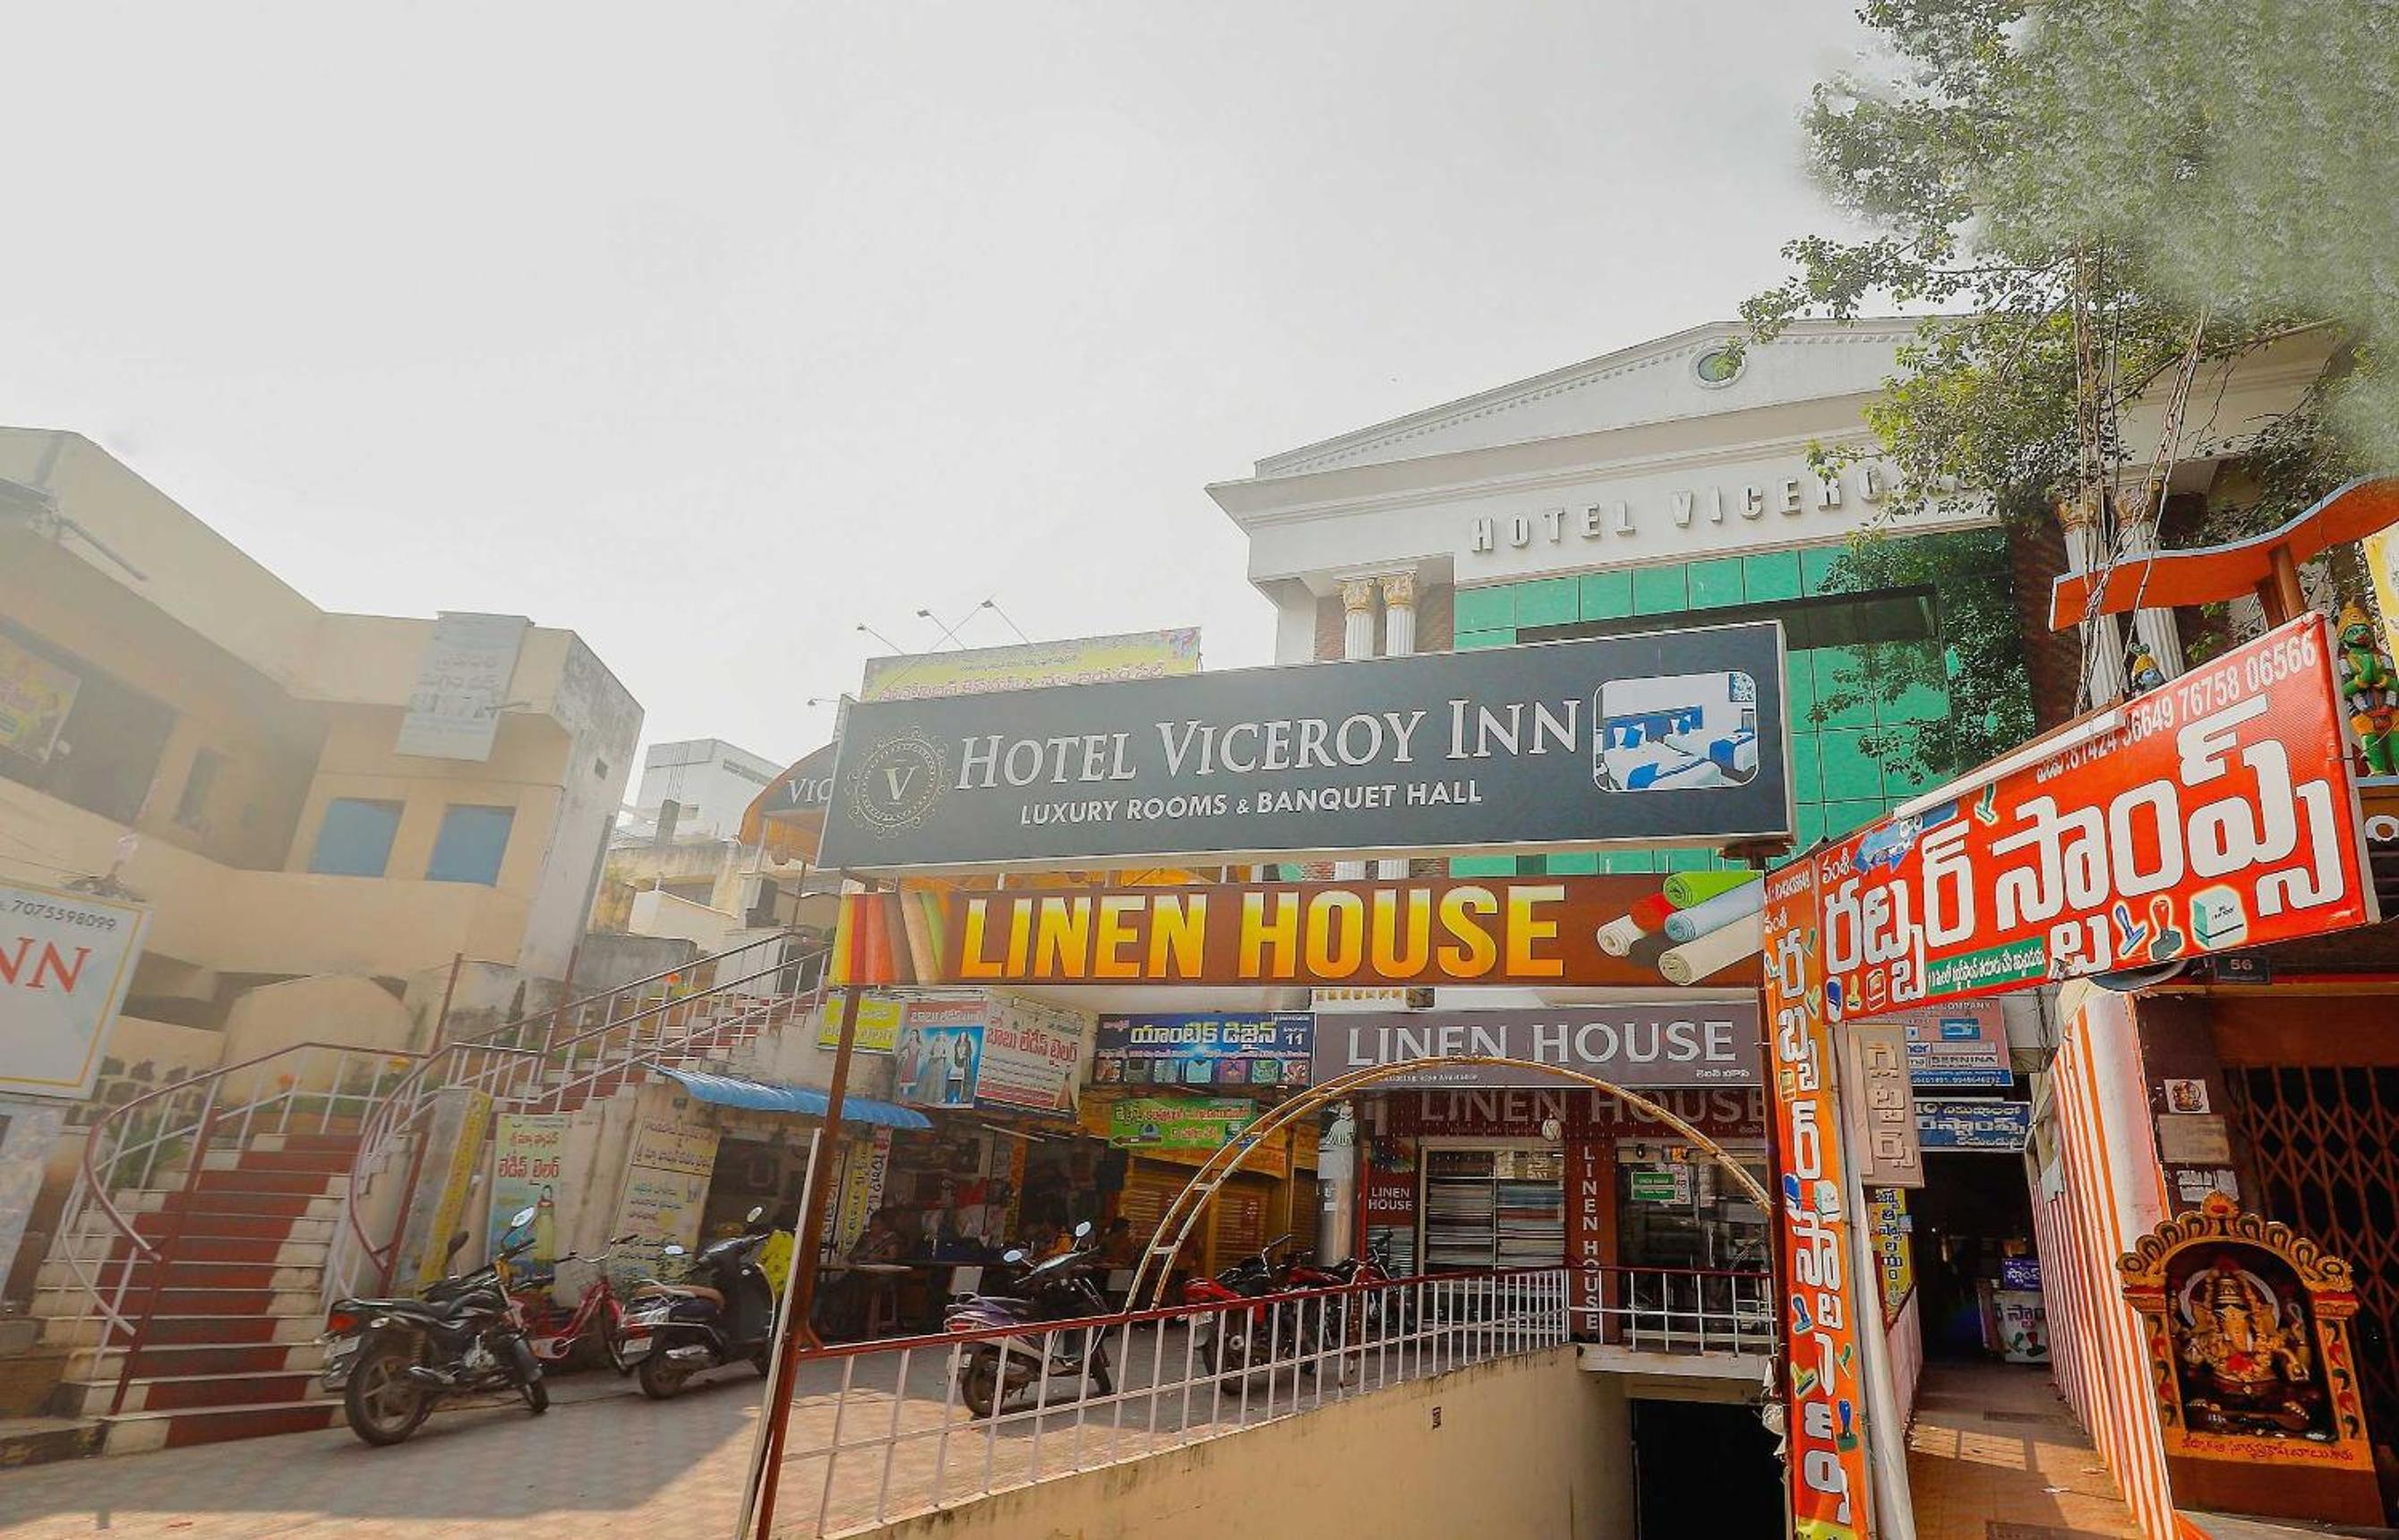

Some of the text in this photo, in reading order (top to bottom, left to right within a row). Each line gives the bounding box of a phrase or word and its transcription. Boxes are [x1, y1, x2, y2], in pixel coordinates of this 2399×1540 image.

[1471, 466, 1884, 552] HOTEL VICERO
[2177, 664, 2241, 722] 76758
[2244, 633, 2318, 692] 06566
[955, 699, 1581, 791] HOTEL VICEROY INN
[1021, 779, 1482, 826] LUXURY ROOMS & BANQUET HALL
[11, 899, 116, 931] 7075598099
[960, 885, 1565, 980] LINEN HOUSE
[1347, 1020, 1736, 1066] LINEN HOUSE
[1420, 1090, 1567, 1123] LINEN
[1368, 1199, 1413, 1211] HOUSE
[1371, 1187, 1410, 1199] LINEN
[1582, 1146, 1598, 1230] LINEN
